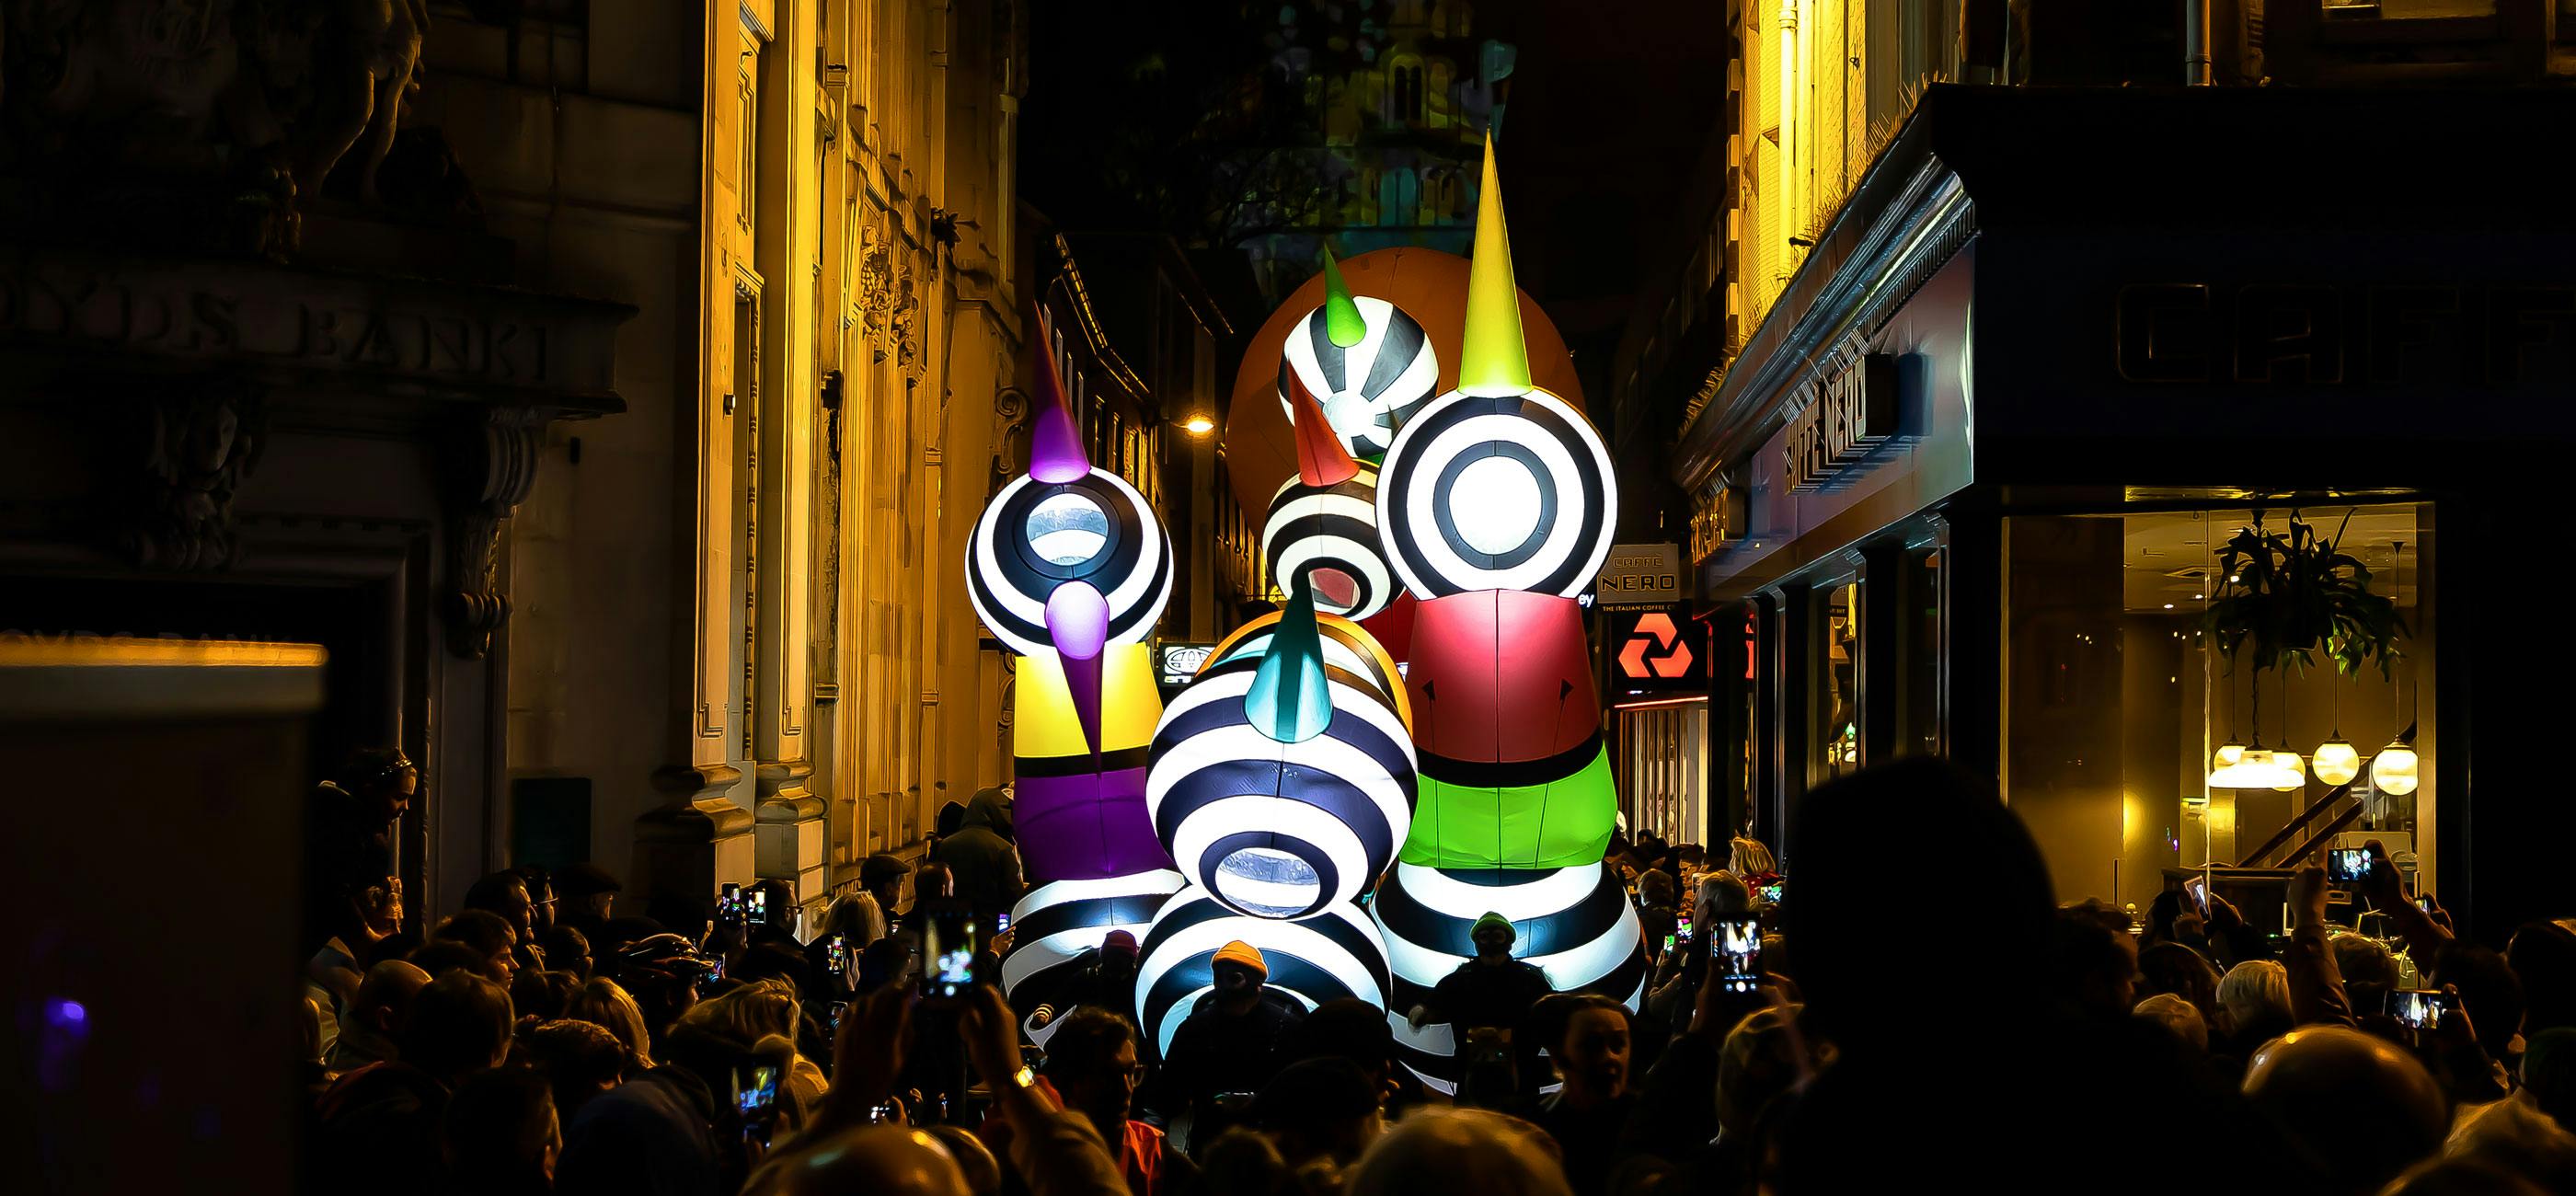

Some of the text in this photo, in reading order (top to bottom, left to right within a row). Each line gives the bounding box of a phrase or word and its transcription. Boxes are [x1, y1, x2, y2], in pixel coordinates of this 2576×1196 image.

[0, 273, 238, 350] YDS
[1825, 355, 1866, 465] NERO
[1601, 574, 1675, 592] NERO
